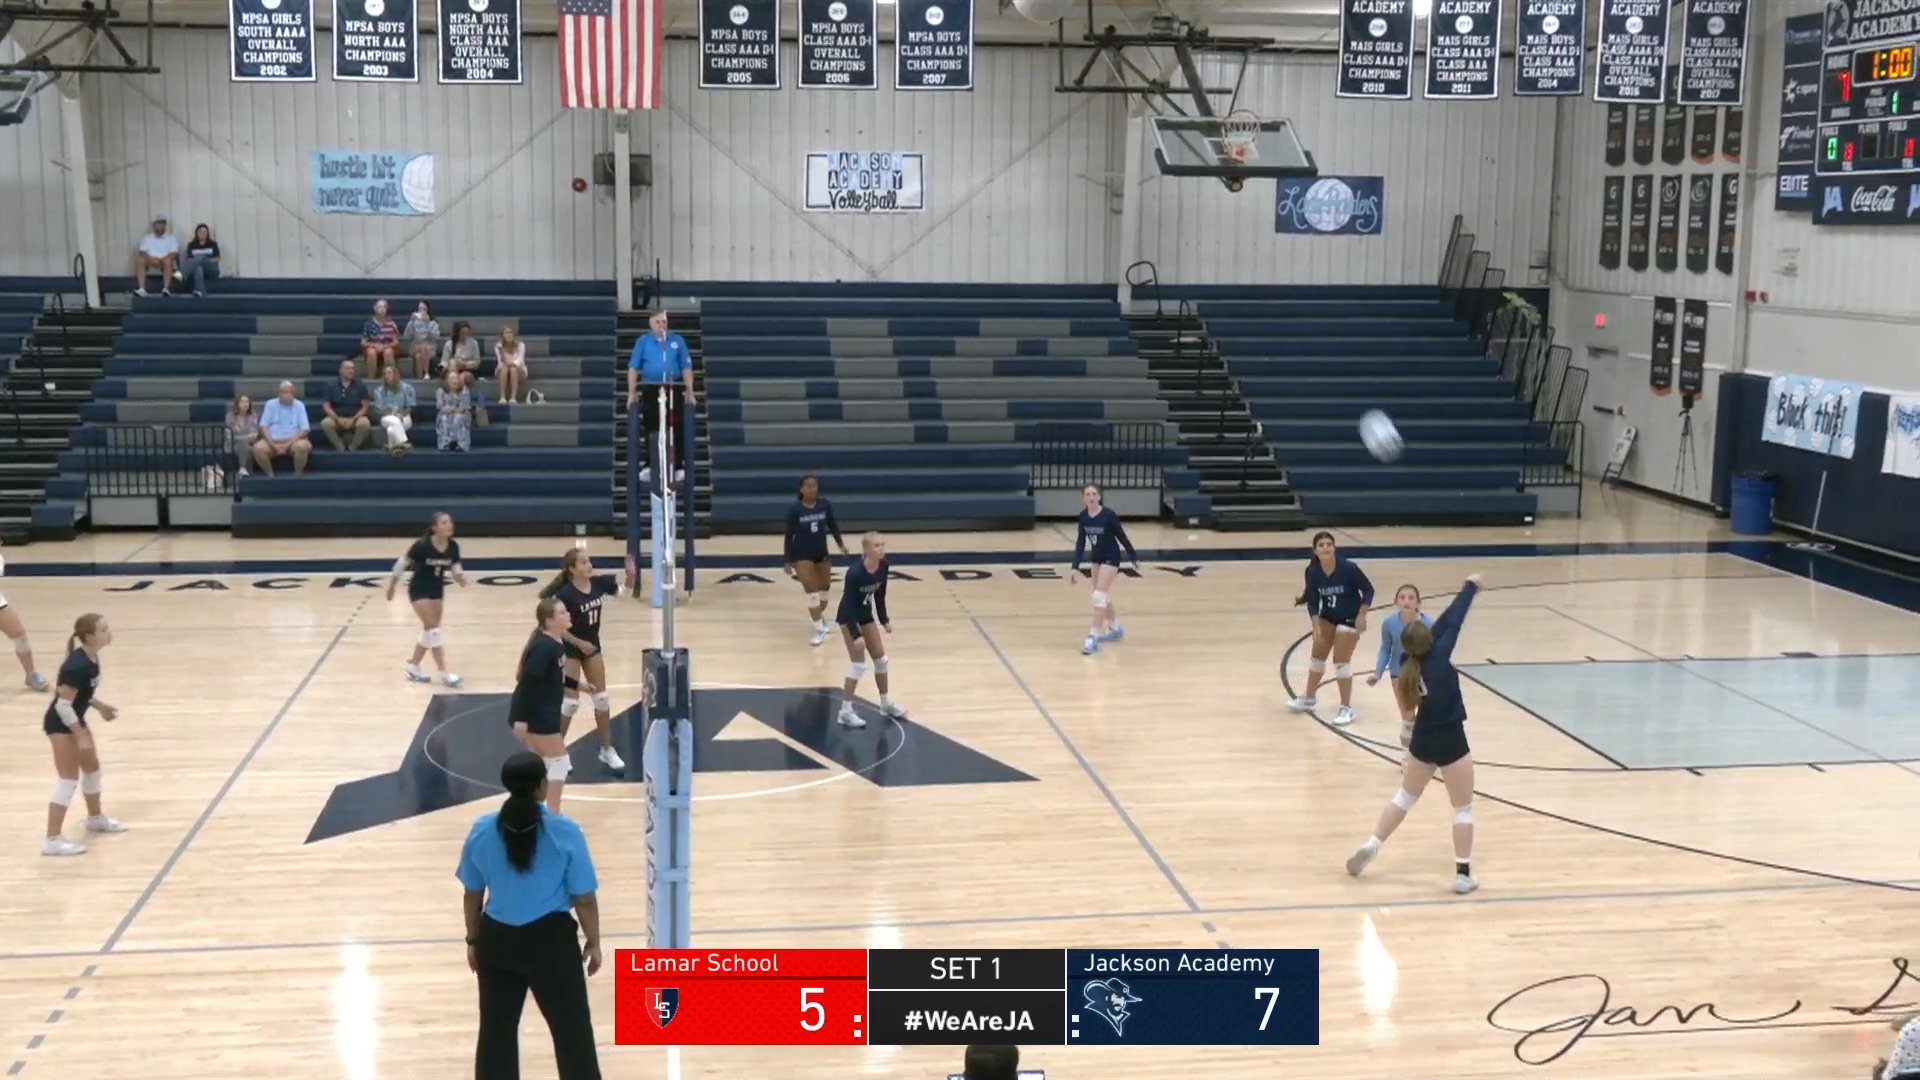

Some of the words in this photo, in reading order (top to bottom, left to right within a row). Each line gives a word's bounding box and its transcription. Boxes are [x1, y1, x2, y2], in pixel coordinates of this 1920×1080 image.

[1352, 2, 1404, 14] ACADEMY
[1439, 2, 1491, 14] ACADEMY
[1527, 4, 1576, 15] ACADEMY
[1610, 4, 1661, 17] ACADEMY
[1692, 2, 1741, 14] ACADEMY
[242, 14, 269, 24] MPSA
[272, 13, 302, 24] GIRLS
[450, 13, 478, 24] MPSA
[482, 14, 508, 24] BOYS
[238, 27, 272, 38] SOUTH
[276, 27, 306, 37] AAAA
[346, 22, 375, 32] MPSA
[378, 22, 404, 33] BOYS
[450, 24, 484, 35] NORTH
[487, 26, 509, 35] AAA
[812, 23, 838, 33] MPSA
[840, 23, 865, 33] BOYS
[711, 29, 739, 40] MPSA
[742, 30, 767, 41] BOYS
[804, 35, 835, 45] CLASS
[837, 36, 858, 45] AAA
[908, 32, 935, 42] MPSA
[937, 32, 961, 42] BOYS
[1551, 35, 1575, 45] BOYS
[248, 40, 296, 50] OVERALL
[344, 36, 381, 47] NORTH
[384, 37, 406, 48] AAA
[450, 36, 483, 46] CLASS
[486, 37, 509, 46] AAA
[1462, 36, 1490, 46] GIRLS
[455, 47, 504, 57] OVERALL
[705, 44, 737, 54] CLASS
[739, 45, 761, 54] AAA
[814, 48, 861, 58] OVERALL
[901, 46, 932, 56] CLASS
[934, 46, 955, 56] AAA
[1432, 47, 1460, 57] CLASS
[1462, 48, 1482, 57] AAA
[1520, 45, 1547, 55] CLASS
[1548, 46, 1568, 55] AAA
[243, 52, 302, 63] CHAMPIONS
[346, 50, 406, 62] CHAMPIONS
[1344, 54, 1374, 65] CLASS
[1375, 56, 1396, 65] AAA
[1602, 55, 1632, 65] CLASS
[452, 58, 509, 68] CHAMPIONS
[711, 58, 768, 69] CHAMPIONS
[810, 60, 865, 72] CHAMPIONS
[907, 60, 961, 70] CHAMPIONS
[1436, 60, 1465, 69] CLASS
[1468, 60, 1488, 69] AAA
[1523, 57, 1552, 67] CLASS
[1555, 57, 1575, 67] AAA
[260, 66, 287, 76] 2002
[363, 65, 388, 76] 2003
[466, 69, 494, 79] 2004
[1349, 67, 1402, 79] CHAMPIONS
[1523, 68, 1575, 78] CHAMPIONS
[1609, 66, 1651, 76] OVERALL
[1691, 68, 1732, 78] OVERALL
[727, 73, 752, 83] 2005
[922, 74, 946, 84] 2007
[1436, 72, 1488, 82] CHAMPIONS
[1604, 75, 1656, 88] CHAMPIONS
[1362, 83, 1385, 92] 2010
[1451, 84, 1472, 93] 2011
[1687, 78, 1735, 89] CHAMPIONS
[1780, 175, 1809, 191] ELITE
[828, 190, 900, 212] Volleyball
